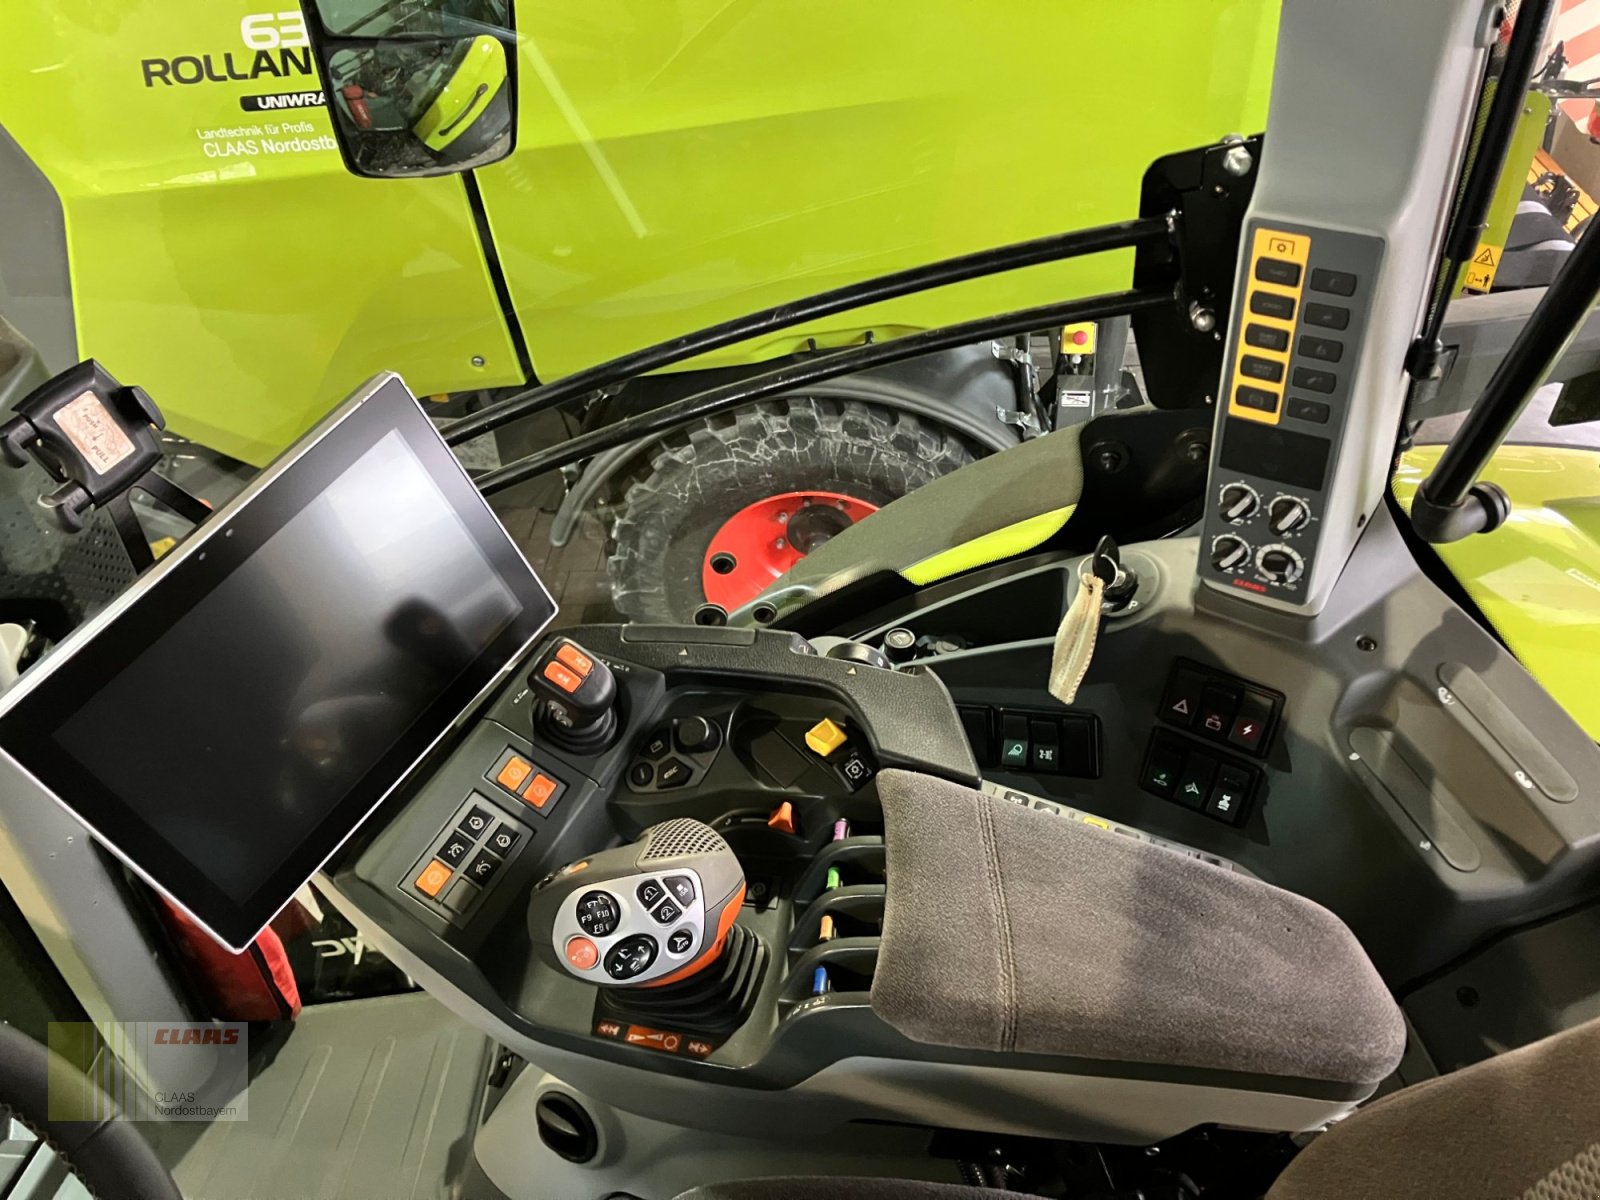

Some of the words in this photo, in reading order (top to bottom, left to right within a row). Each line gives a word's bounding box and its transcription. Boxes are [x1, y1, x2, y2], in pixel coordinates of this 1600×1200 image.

[141, 46, 314, 87] ROLLAN
[196, 125, 264, 140] Landtechnik
[264, 123, 280, 136] für
[282, 122, 314, 134] Profis
[203, 140, 259, 158] CLAAS
[262, 135, 337, 155] Nordostb
[91, 445, 109, 463] PULL
[1128, 600, 1138, 610] P
[581, 914, 592, 923] F9
[596, 910, 610, 918] F10
